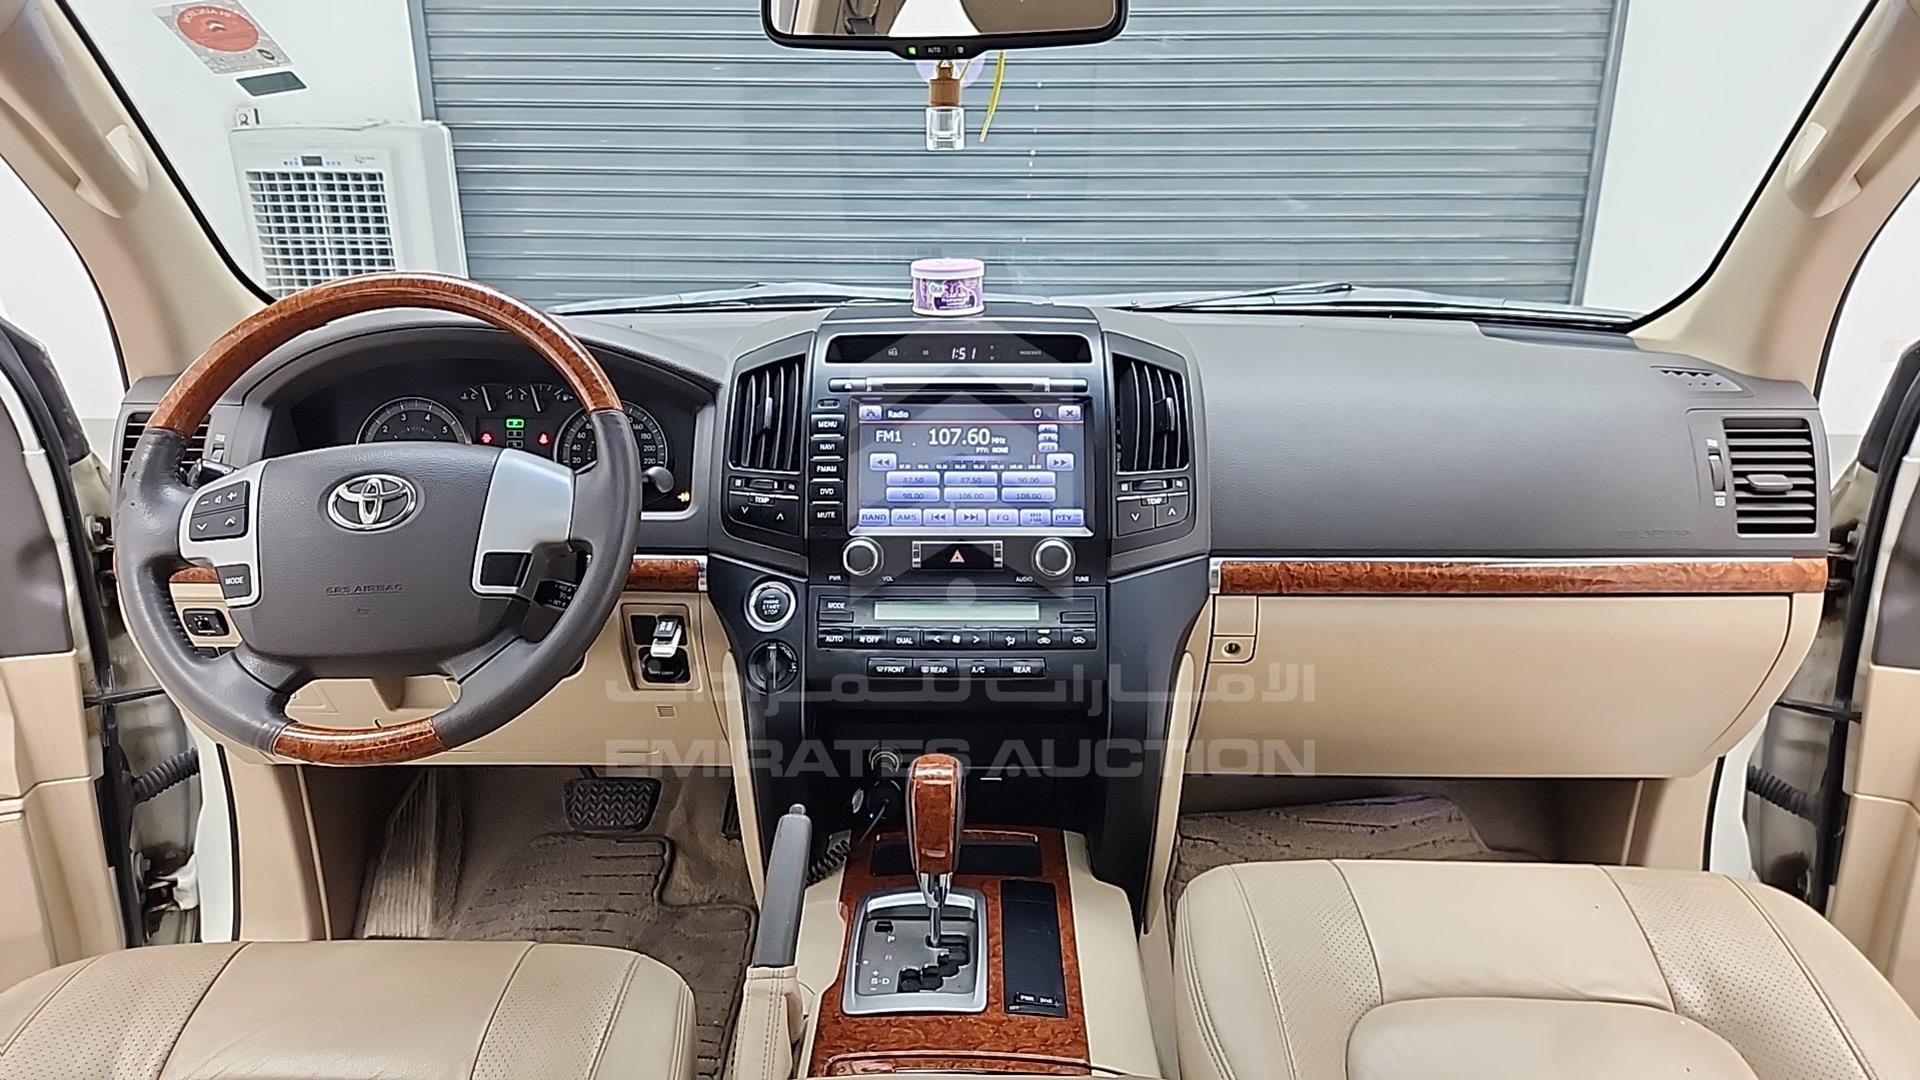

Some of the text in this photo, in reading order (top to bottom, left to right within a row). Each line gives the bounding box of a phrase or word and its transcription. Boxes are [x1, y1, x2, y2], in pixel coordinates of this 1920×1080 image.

[951, 347, 977, 360] 1:51
[401, 413, 407, 421] 3
[425, 413, 431, 421] 4
[887, 409, 909, 419] Radio
[382, 425, 388, 433] 2
[442, 425, 448, 434] 5
[875, 430, 902, 443] FM1
[928, 428, 991, 445] 107.60
[819, 443, 836, 451] NAVI
[861, 513, 887, 521] BAND
[897, 513, 917, 521] AMS
[225, 576, 244, 586] MODE
[354, 584, 404, 594] AIRBAG
[825, 635, 844, 643] AUTO
[896, 637, 913, 645] DUAL
[1012, 666, 1032, 674] REAR
